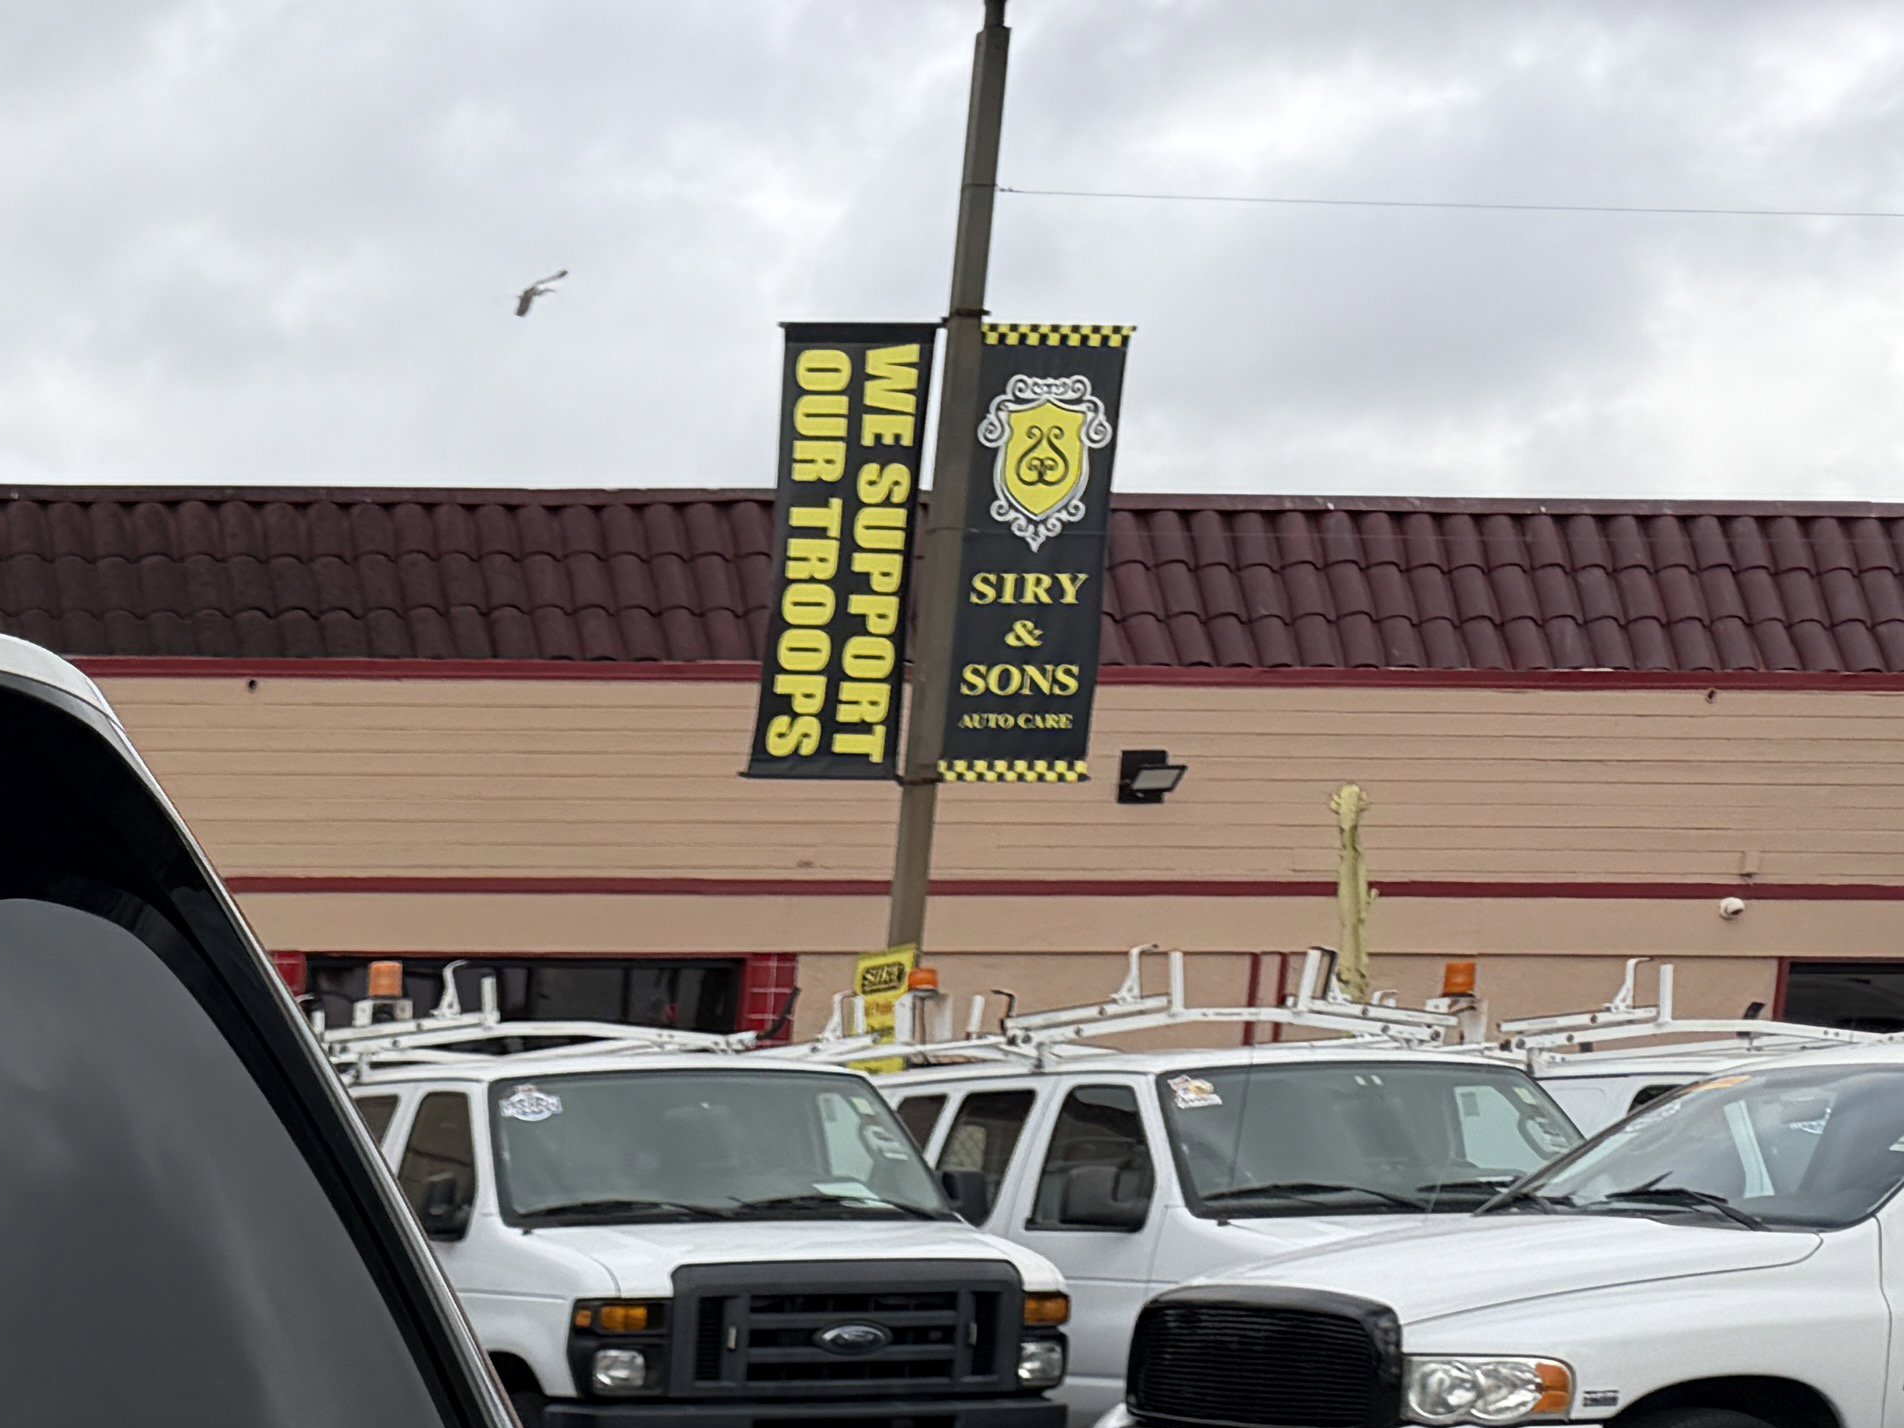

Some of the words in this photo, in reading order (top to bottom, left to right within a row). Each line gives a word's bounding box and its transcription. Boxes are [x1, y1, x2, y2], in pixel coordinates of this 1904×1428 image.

[791, 349, 852, 482] OUR
[863, 344, 920, 447] WE
[832, 463, 911, 762] SUPPORT
[970, 573, 1089, 605] SIRY
[766, 497, 842, 757] TROOPS
[1005, 620, 1043, 647] &
[960, 664, 1079, 696] SONS
[959, 714, 1014, 729] AUTO
[1017, 714, 1073, 729] CARE
